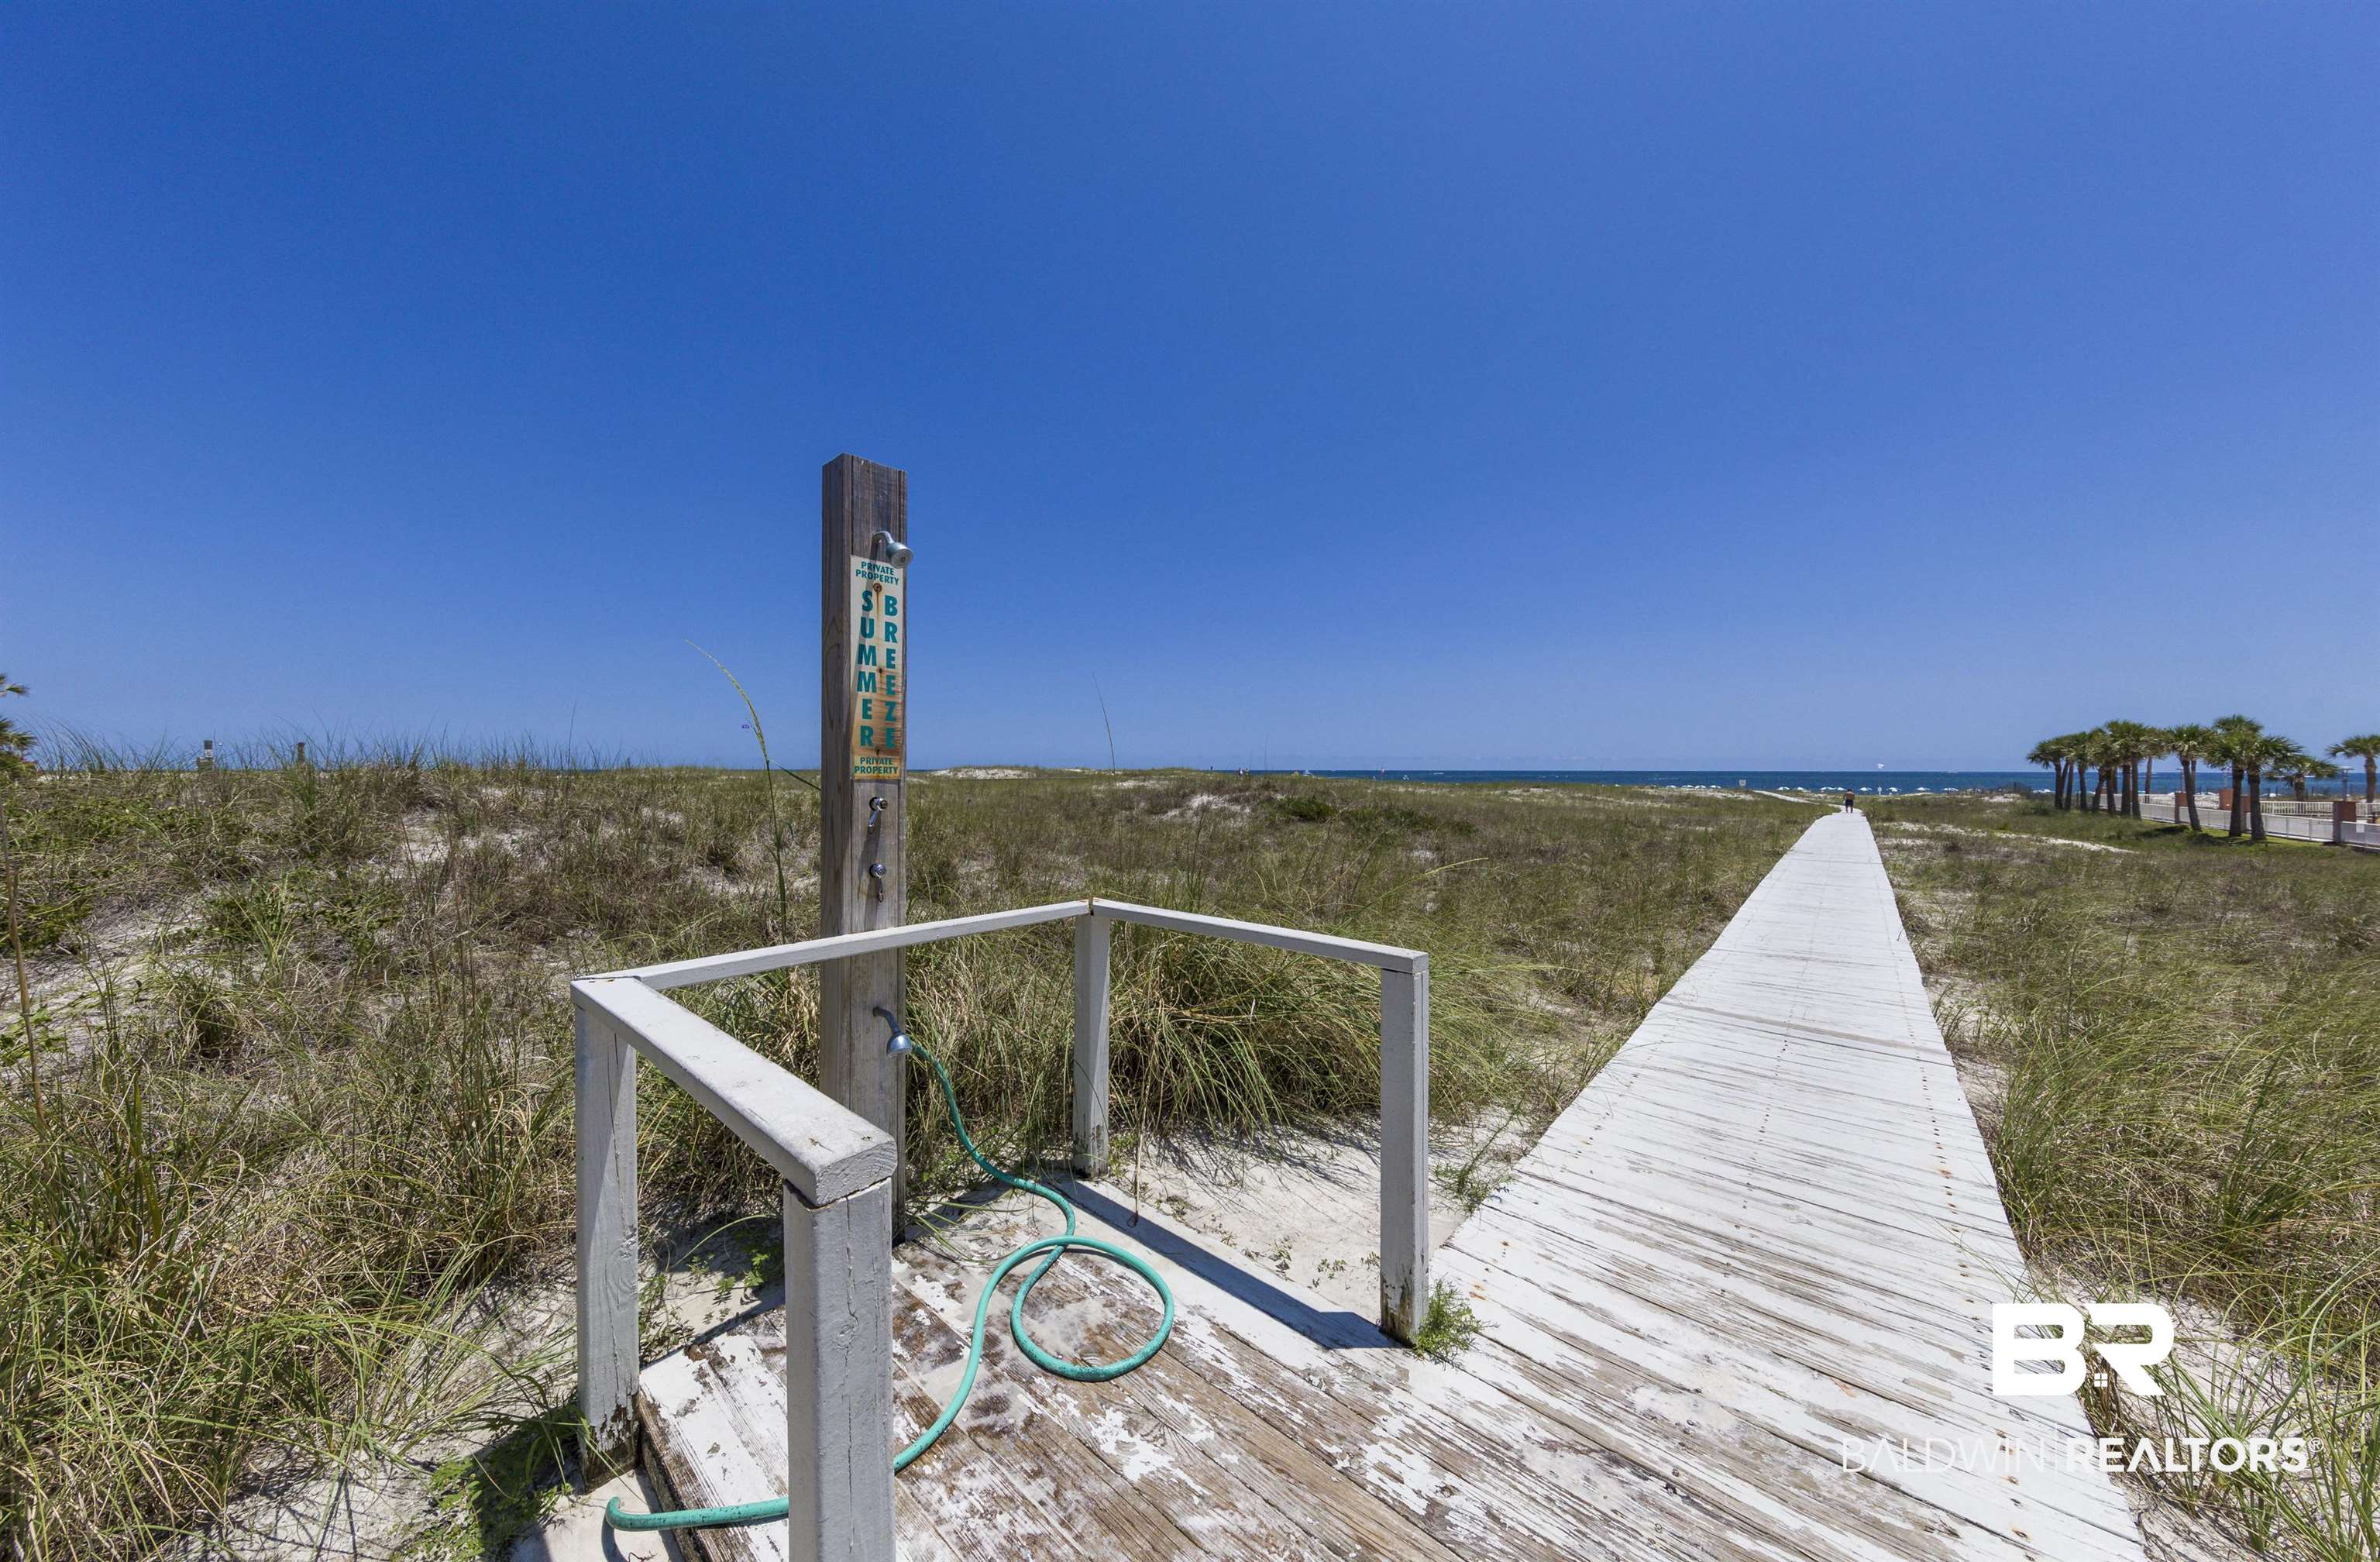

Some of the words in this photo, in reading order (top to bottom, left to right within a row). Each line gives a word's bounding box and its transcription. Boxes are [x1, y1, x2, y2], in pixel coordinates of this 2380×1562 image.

[861, 561, 894, 575] PRIVATE
[855, 569, 899, 585] PROPERTY
[857, 590, 877, 747] SUMMER
[884, 594, 898, 748] BREEZE
[855, 766, 899, 774] PROPERTY
